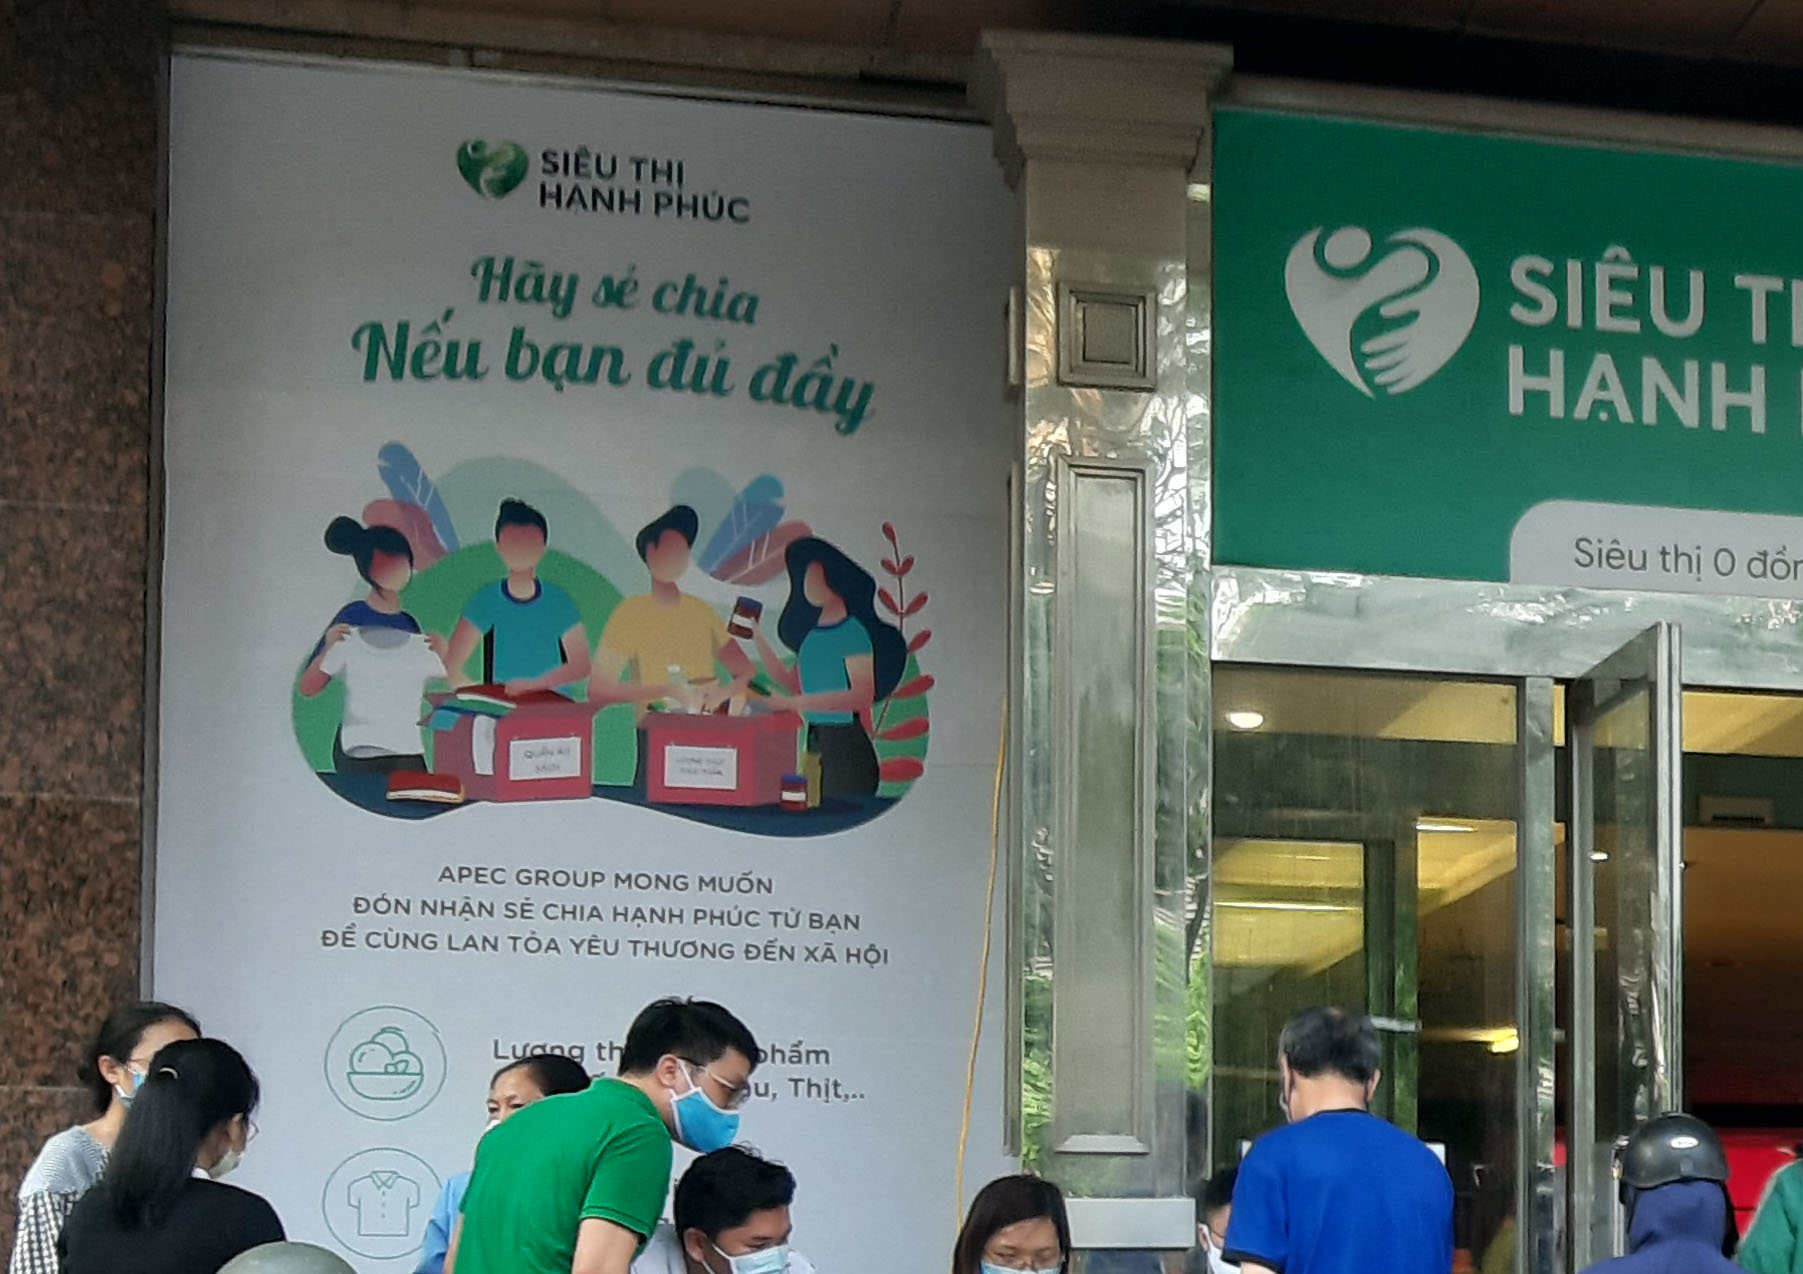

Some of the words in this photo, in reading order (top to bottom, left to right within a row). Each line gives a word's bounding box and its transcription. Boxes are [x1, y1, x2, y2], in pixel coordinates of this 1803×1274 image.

[540, 145, 618, 181] SIÊU
[629, 155, 684, 189] THỊ
[539, 181, 642, 216] HẠNH
[653, 189, 750, 224] PHÚC
[470, 254, 577, 319] Hãy
[591, 266, 641, 309] sẻ
[651, 271, 761, 325] chia
[1507, 245, 1707, 338] SIÊU
[350, 307, 490, 383] Nếu
[505, 325, 632, 393] bạn
[646, 337, 737, 398] đủ
[748, 342, 877, 436] đầy
[1507, 345, 1768, 436] HẠNH
[1574, 536, 1648, 571] Siêu
[1658, 544, 1702, 582] thị
[1713, 547, 1737, 577] 0
[437, 866, 507, 886] APEC
[514, 868, 606, 889] GROUP
[613, 872, 690, 892] MONG
[697, 870, 774, 895] MUỐN
[352, 892, 411, 917] ĐÓN
[419, 896, 496, 922] NHẬN
[503, 896, 535, 920] SẺ
[542, 903, 605, 923] CHIA
[611, 905, 685, 928] HẠNH
[692, 904, 762, 929] PHÚC
[768, 908, 802, 930] TỪ
[807, 912, 861, 934] BẠN
[320, 922, 357, 949] ĐỂ
[364, 927, 439, 951] CÙNG
[447, 934, 500, 953] LAN
[507, 930, 562, 955] TỎA
[569, 934, 620, 957] YÊU
[627, 939, 736, 961] THƯƠNG
[744, 937, 796, 962] ĐẾN
[803, 942, 838, 964] XÃ
[845, 944, 889, 970] HỘI
